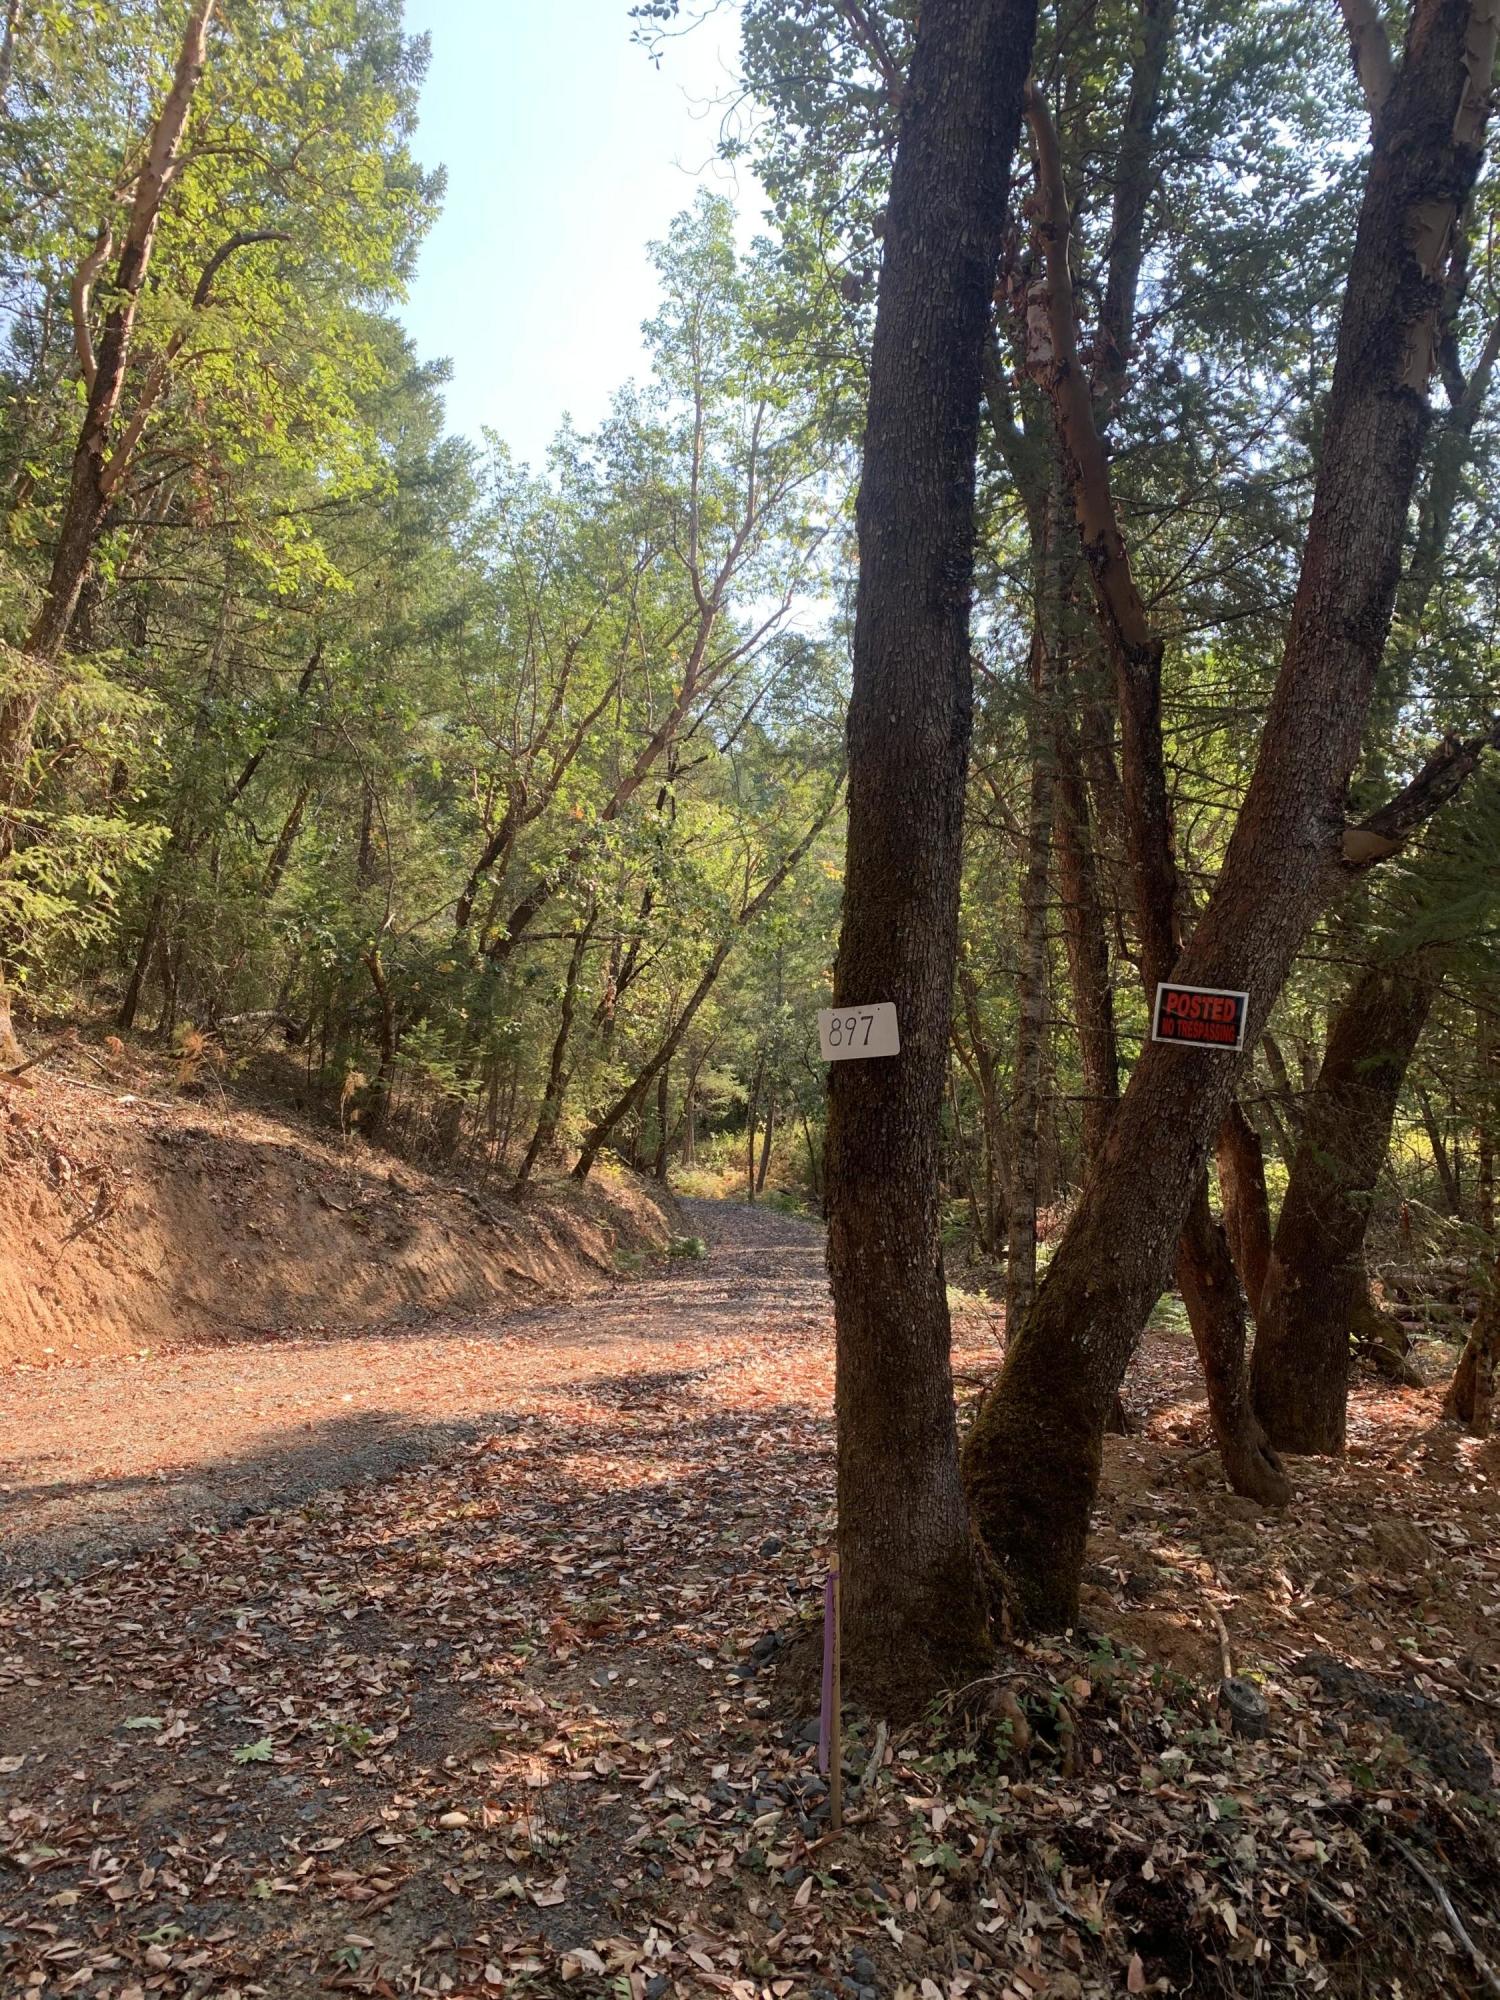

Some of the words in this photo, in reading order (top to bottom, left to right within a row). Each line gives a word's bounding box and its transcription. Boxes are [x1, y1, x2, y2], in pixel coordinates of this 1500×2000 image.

[1167, 992, 1236, 1022] POSTED
[829, 1016, 873, 1046] 897
[1162, 1017, 1175, 1035] NO
[1177, 1020, 1235, 1042] TRESPASSING
